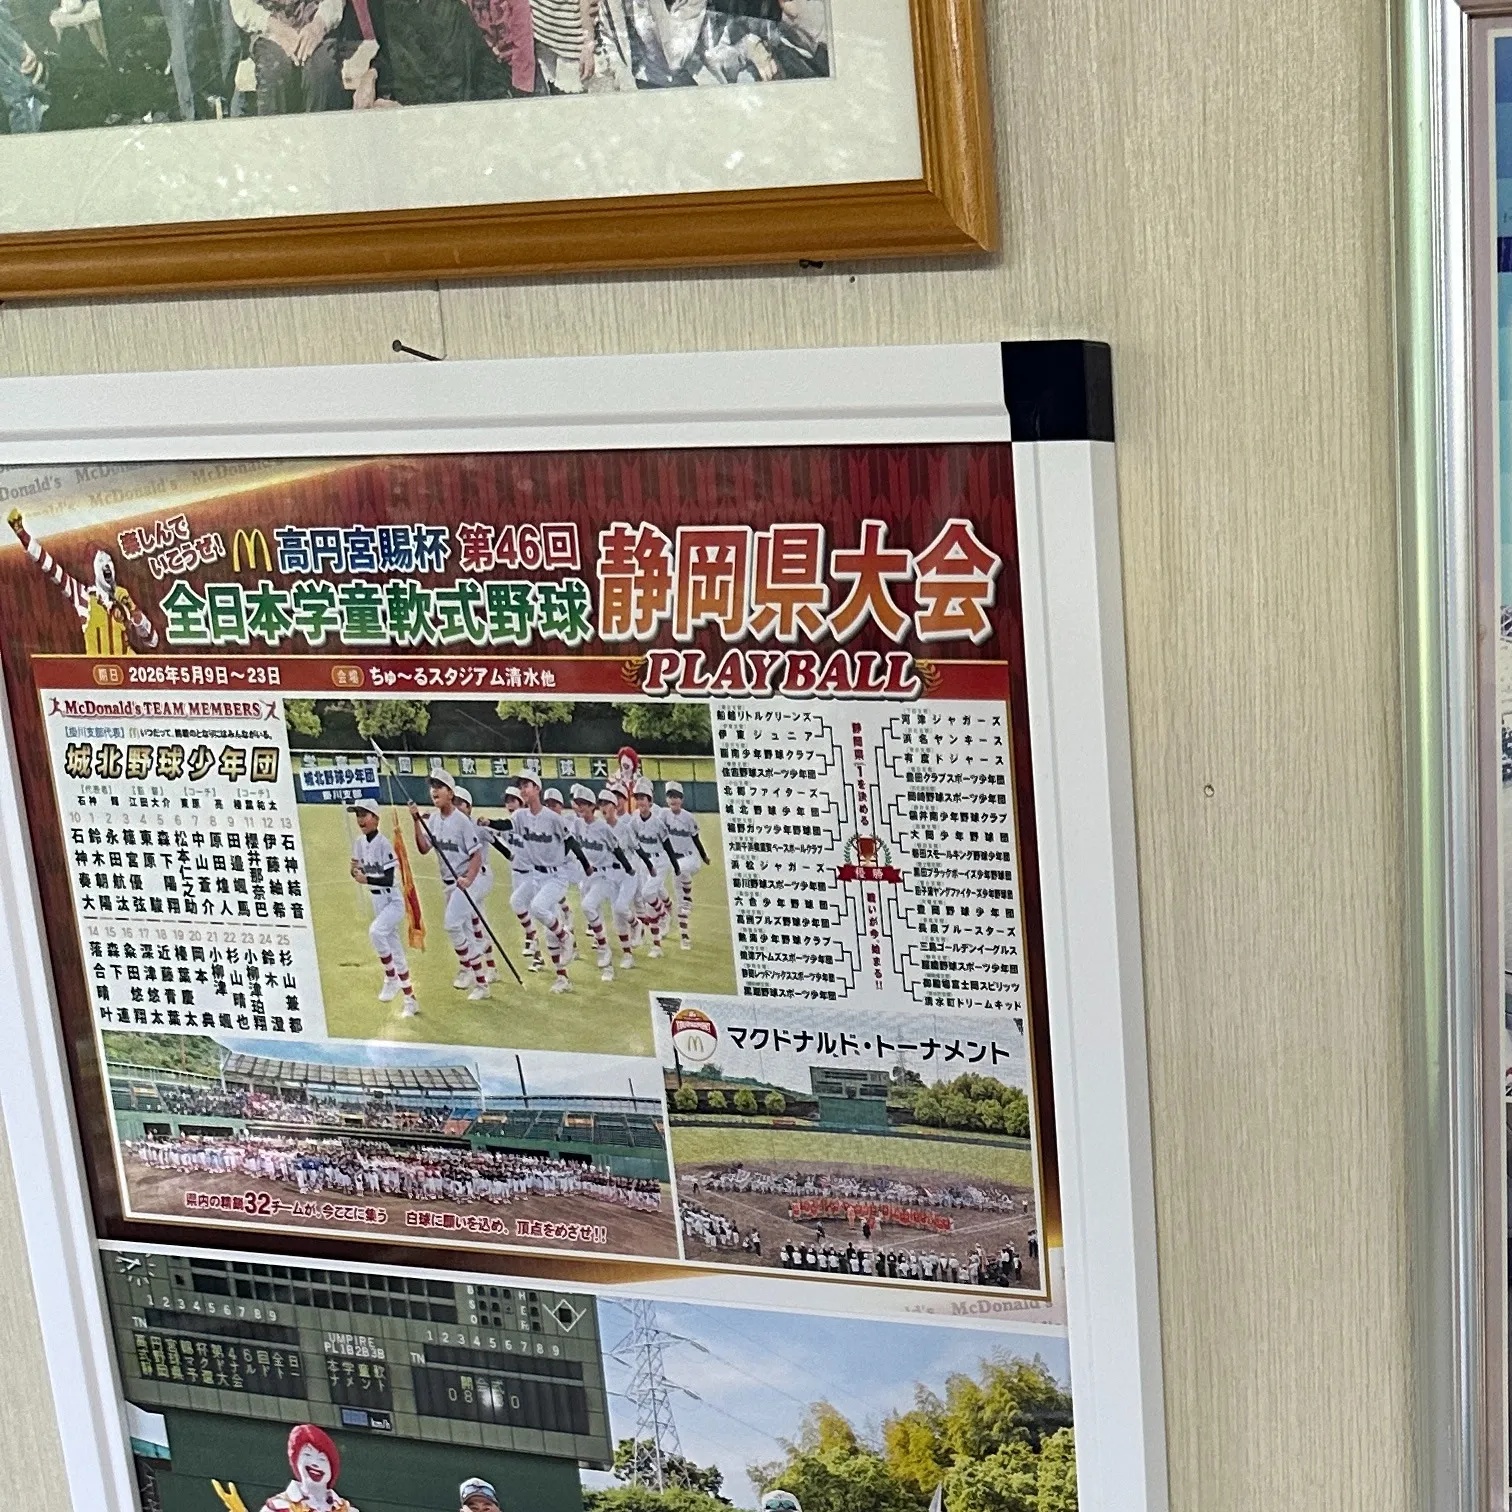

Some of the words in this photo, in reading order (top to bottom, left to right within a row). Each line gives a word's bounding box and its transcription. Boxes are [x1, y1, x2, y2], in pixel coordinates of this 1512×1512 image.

[274, 526, 449, 574] 高円宮賜杯
[457, 522, 581, 572] 第46回
[598, 518, 1002, 647] 静岡県大会
[160, 577, 594, 648] 全日本学童軟式野球
[143, 702, 185, 716] TEAM
[189, 702, 261, 717] MEMBERS
[64, 742, 280, 783] 城北野球少年団
